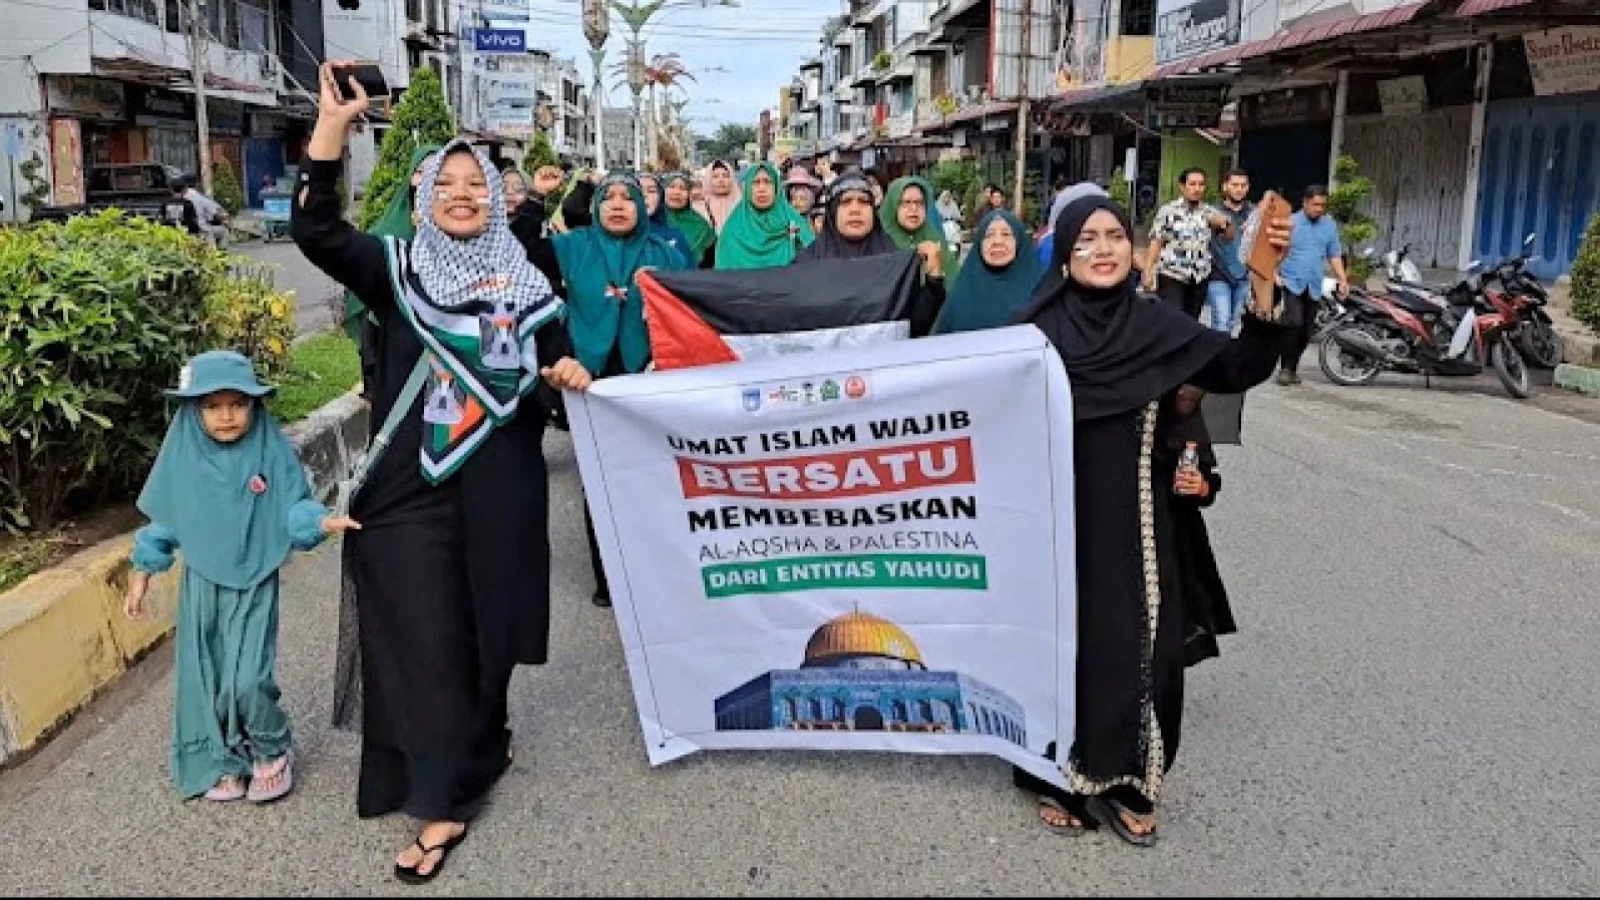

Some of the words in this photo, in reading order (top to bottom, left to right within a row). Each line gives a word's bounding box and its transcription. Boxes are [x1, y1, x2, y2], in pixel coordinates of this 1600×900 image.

[480, 33, 521, 46] vivo
[667, 435, 748, 455] UMAT
[760, 424, 856, 452] ISLAM
[869, 410, 972, 442] WAJIB
[691, 446, 960, 494] BERSATU
[688, 496, 977, 533] MEMBEBASKAN
[700, 535, 818, 562] AL-AQSHA
[824, 536, 842, 552] &
[849, 531, 979, 553] PALESTINA
[709, 568, 768, 589] DARI
[776, 560, 877, 584] ENTITAS
[884, 560, 981, 581] YAHUDI
